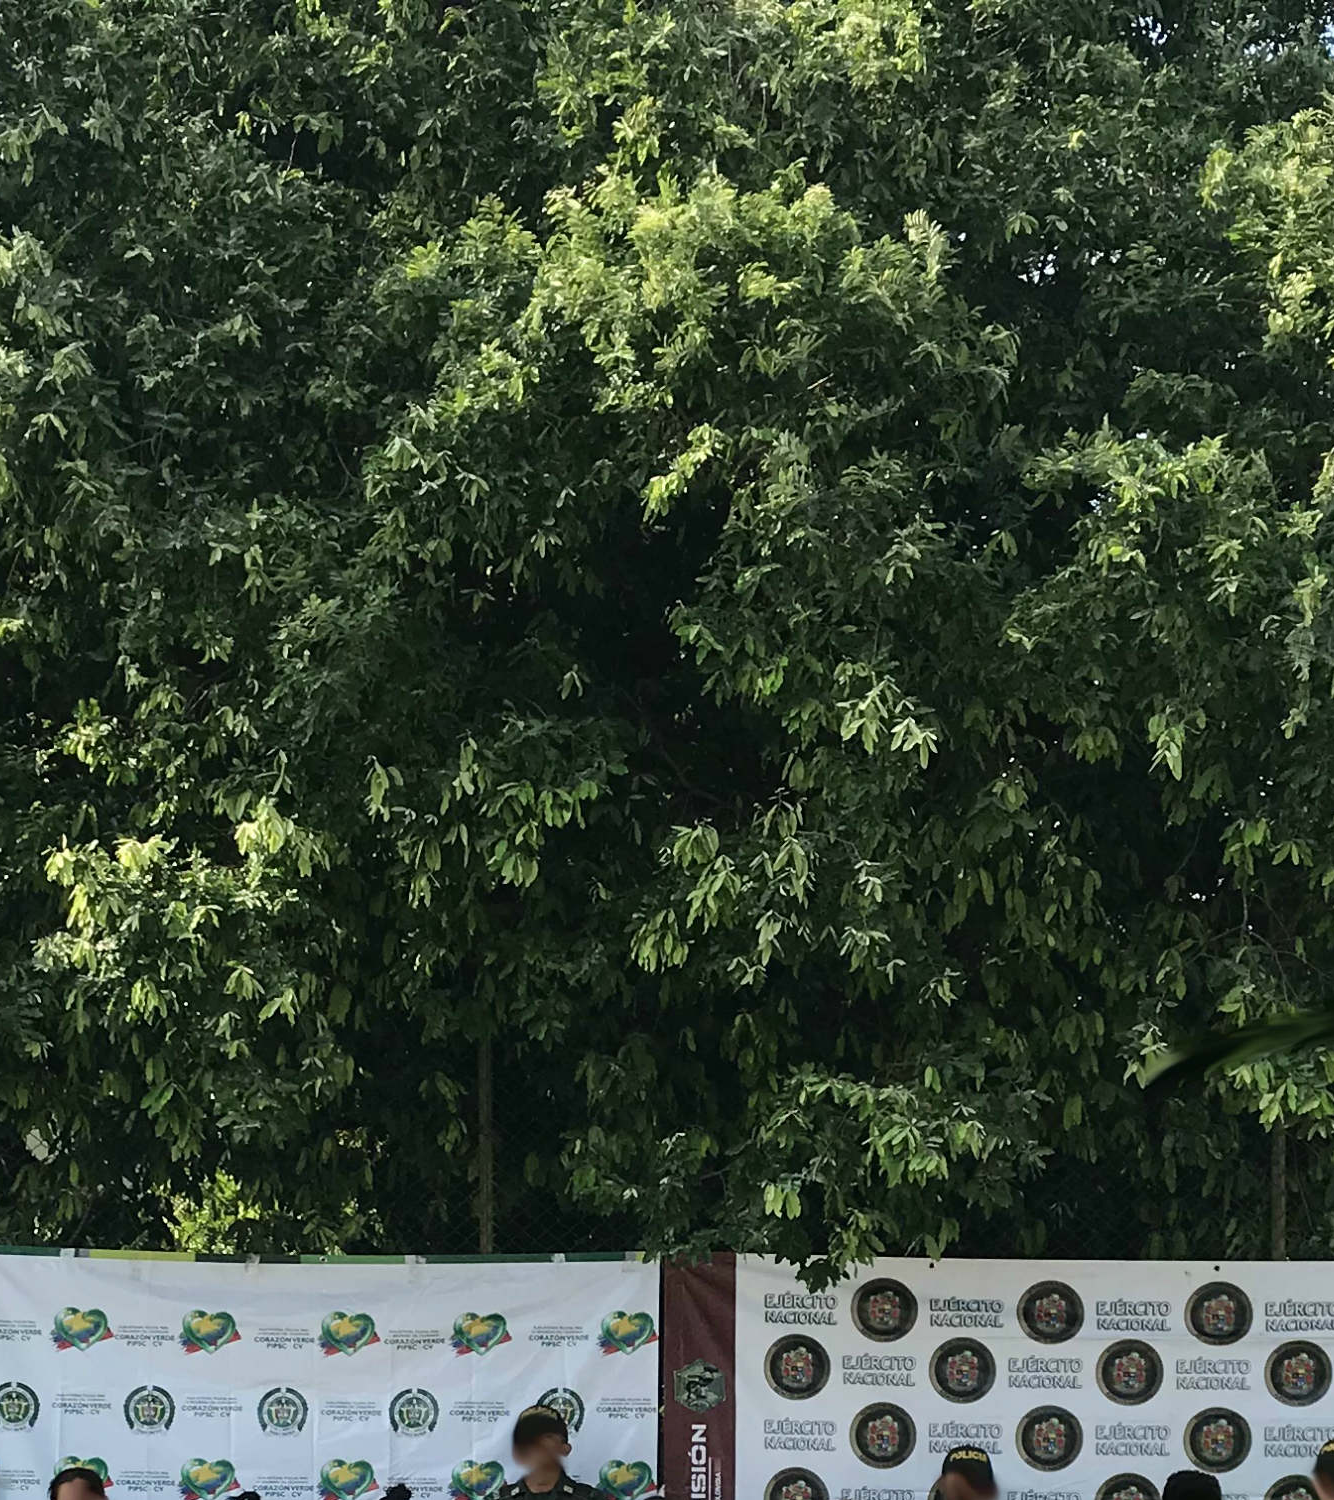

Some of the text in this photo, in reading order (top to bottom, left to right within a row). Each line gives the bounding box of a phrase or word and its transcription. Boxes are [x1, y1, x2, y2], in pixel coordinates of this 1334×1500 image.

[764, 1291, 838, 1310] EJÉRCITO
[929, 1296, 1004, 1313] EJÉRCITO
[1095, 1298, 1172, 1317] EJÉRCITO
[764, 1310, 837, 1326] NACIONAL
[929, 1313, 1004, 1328] NACIONAL
[1096, 1317, 1171, 1331] NACIONAL
[842, 1352, 917, 1372] EJÉRCITO
[1008, 1355, 1084, 1373] EJÉRCITO
[1176, 1356, 1251, 1375] EJÉRCITO
[843, 1371, 916, 1387] NACIONAL
[1008, 1374, 1083, 1389] NACIONAL
[1176, 1375, 1251, 1391] NACIONAL
[764, 1417, 837, 1436] EJÉRCITO
[929, 1420, 1003, 1440] EJÉRCITO
[1095, 1422, 1171, 1441] EJÉRCITO
[764, 1435, 836, 1452] NACIONAL
[1095, 1441, 1170, 1457] NACIONAL
[1264, 1443, 1319, 1458] NACION
